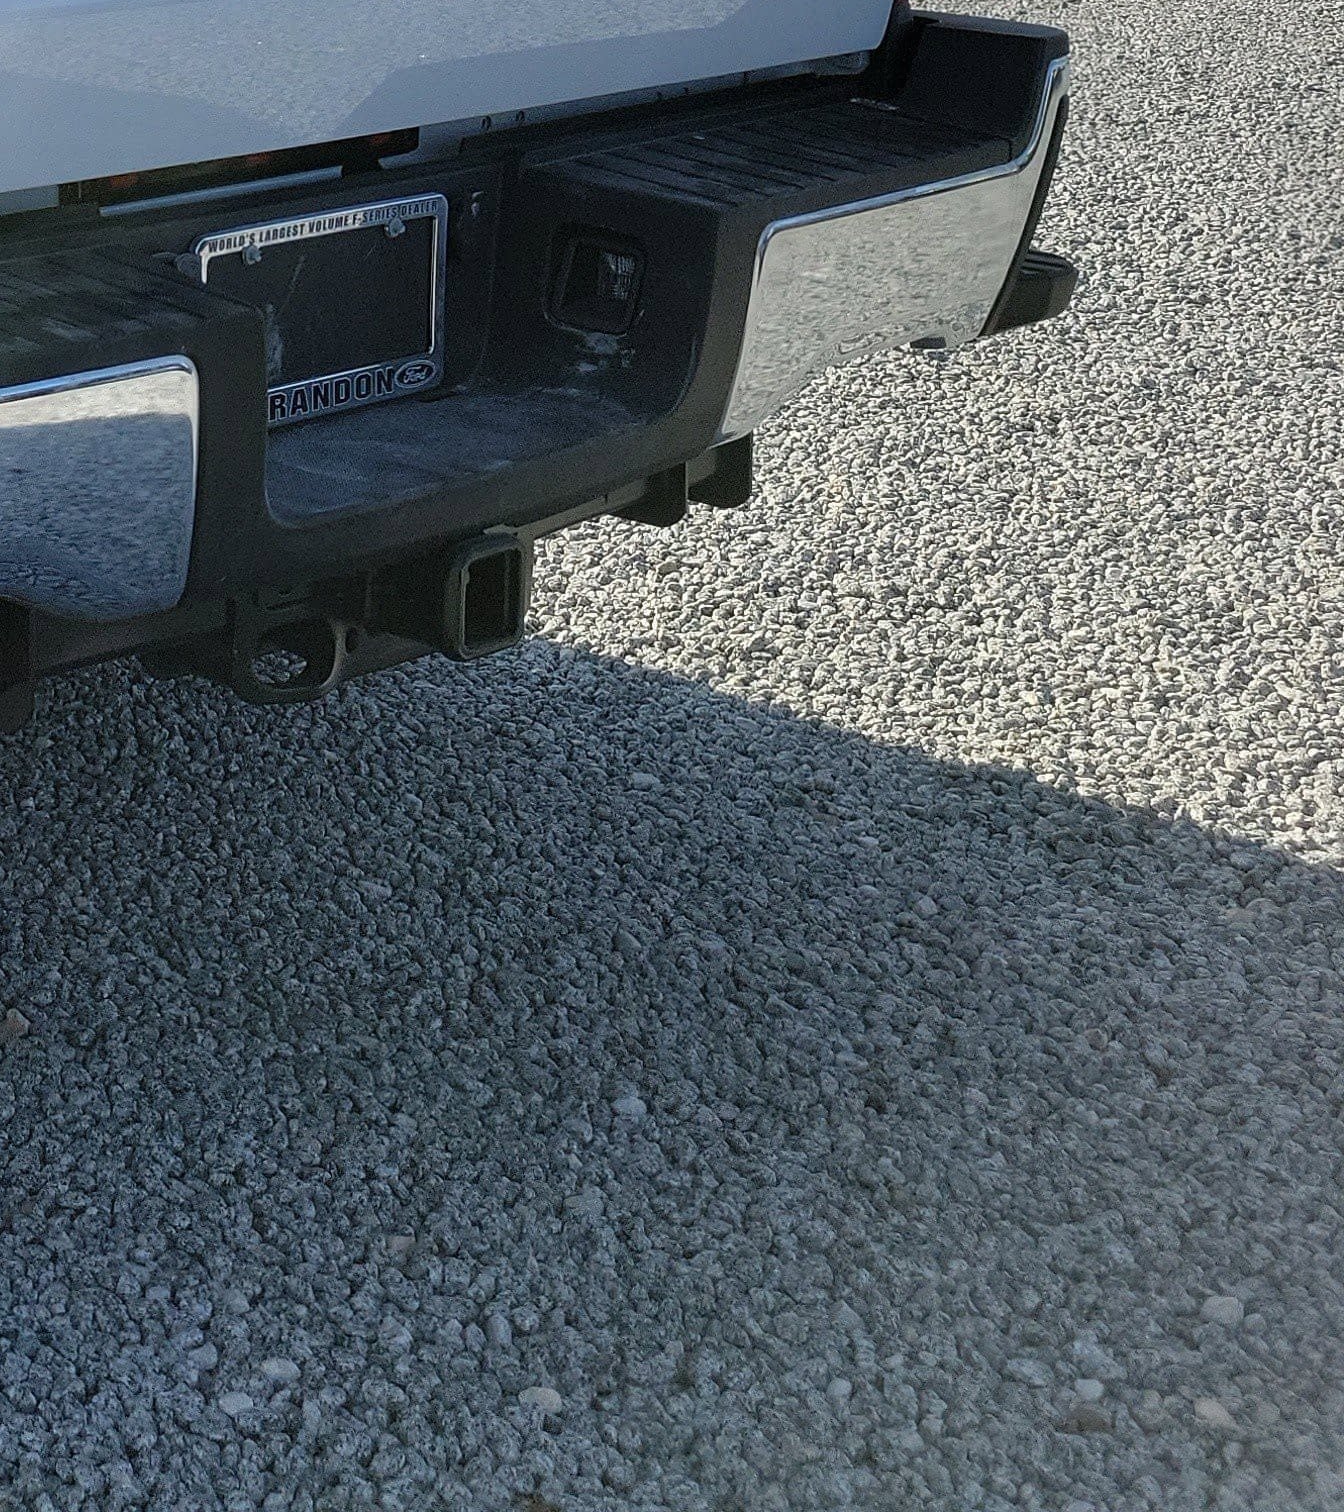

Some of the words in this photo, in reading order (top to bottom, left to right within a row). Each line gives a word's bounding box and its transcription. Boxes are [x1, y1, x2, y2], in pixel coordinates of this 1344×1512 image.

[208, 232, 256, 253] WORLD'S
[259, 223, 305, 244] LARGEST
[308, 215, 350, 233] VOLUME
[352, 206, 398, 226] F-SERIES
[400, 199, 439, 216] DEALER
[267, 365, 394, 423] RANDON
[402, 365, 429, 385] Ford
